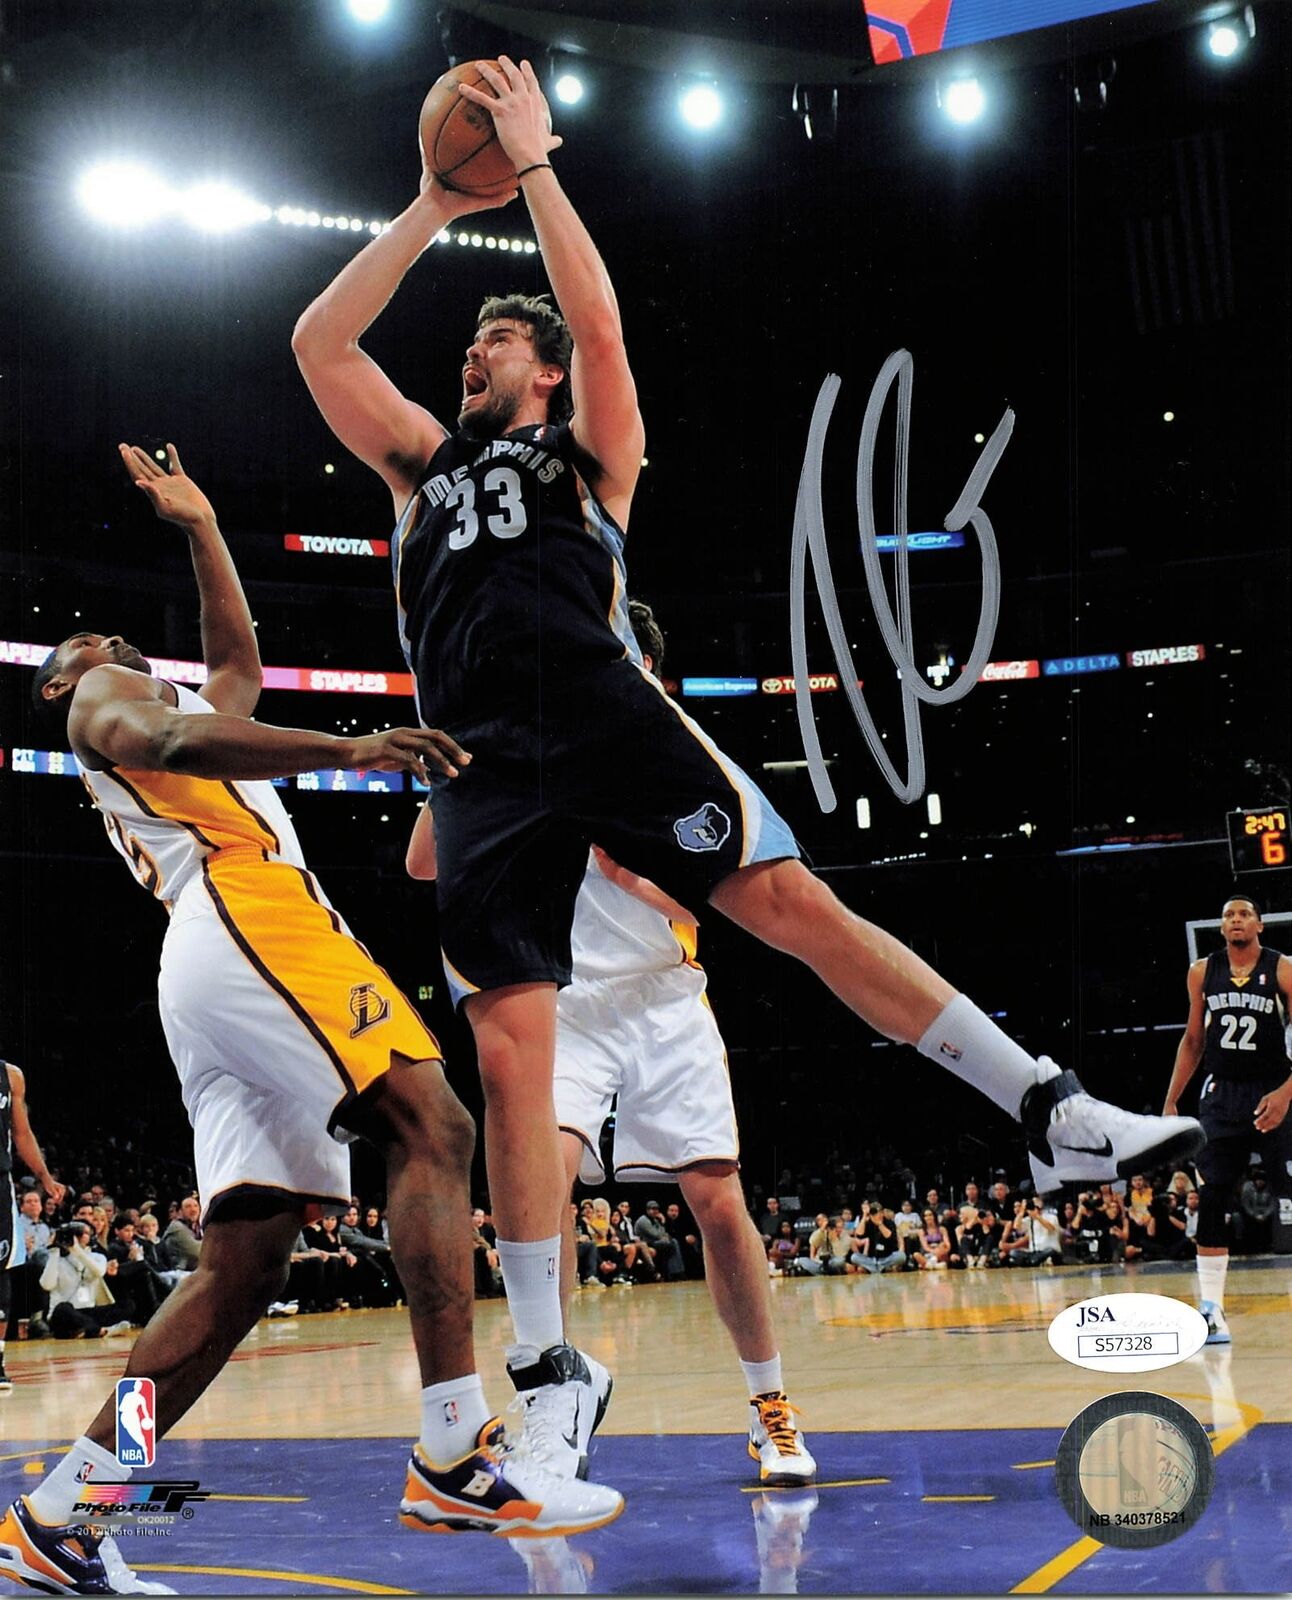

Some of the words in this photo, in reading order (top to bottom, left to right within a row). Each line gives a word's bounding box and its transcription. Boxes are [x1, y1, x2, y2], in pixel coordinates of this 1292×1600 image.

[445, 467, 528, 551] 33
[299, 535, 374, 556] TOYOTA
[1063, 655, 1121, 672] DELTA
[1132, 646, 1200, 667] STAPLES
[310, 670, 388, 693] STAPLES
[783, 677, 837, 690] TOTA
[1245, 812, 1286, 835] 2:47
[1261, 831, 1286, 865] 6
[1207, 992, 1274, 1014] MEMPHIS
[1220, 1014, 1257, 1050] 22
[1076, 1306, 1116, 1328] JSA
[1095, 1336, 1153, 1352] S57328
[1090, 1514, 1111, 1527] NB
[1114, 1512, 1185, 1526] 340378521
